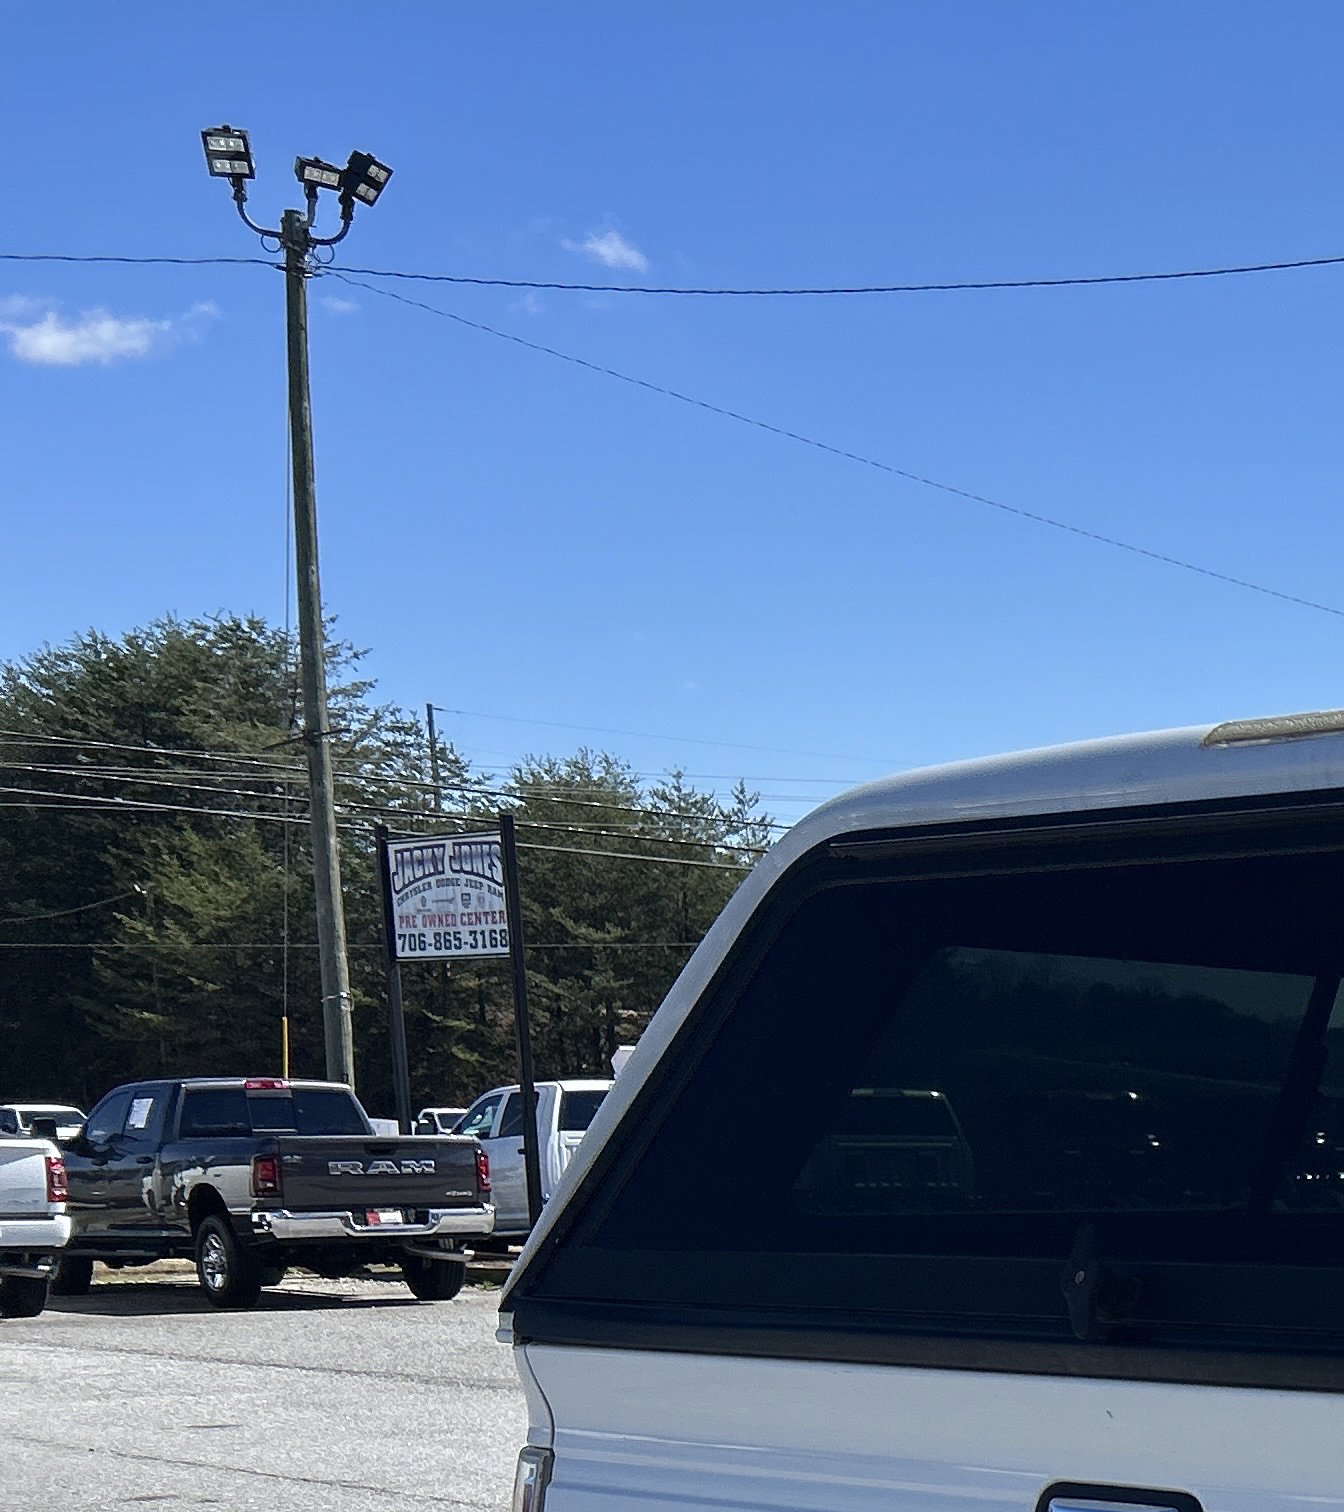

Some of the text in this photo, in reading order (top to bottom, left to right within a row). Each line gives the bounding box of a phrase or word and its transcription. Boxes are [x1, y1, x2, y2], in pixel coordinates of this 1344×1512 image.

[392, 841, 503, 894] JACKY JONES
[436, 878, 461, 888] DODGE
[464, 879, 484, 891] JEEP
[398, 910, 507, 929] PRE OWNED CENTER
[398, 929, 509, 953] 706-865-3168
[328, 1160, 436, 1175] RAM
